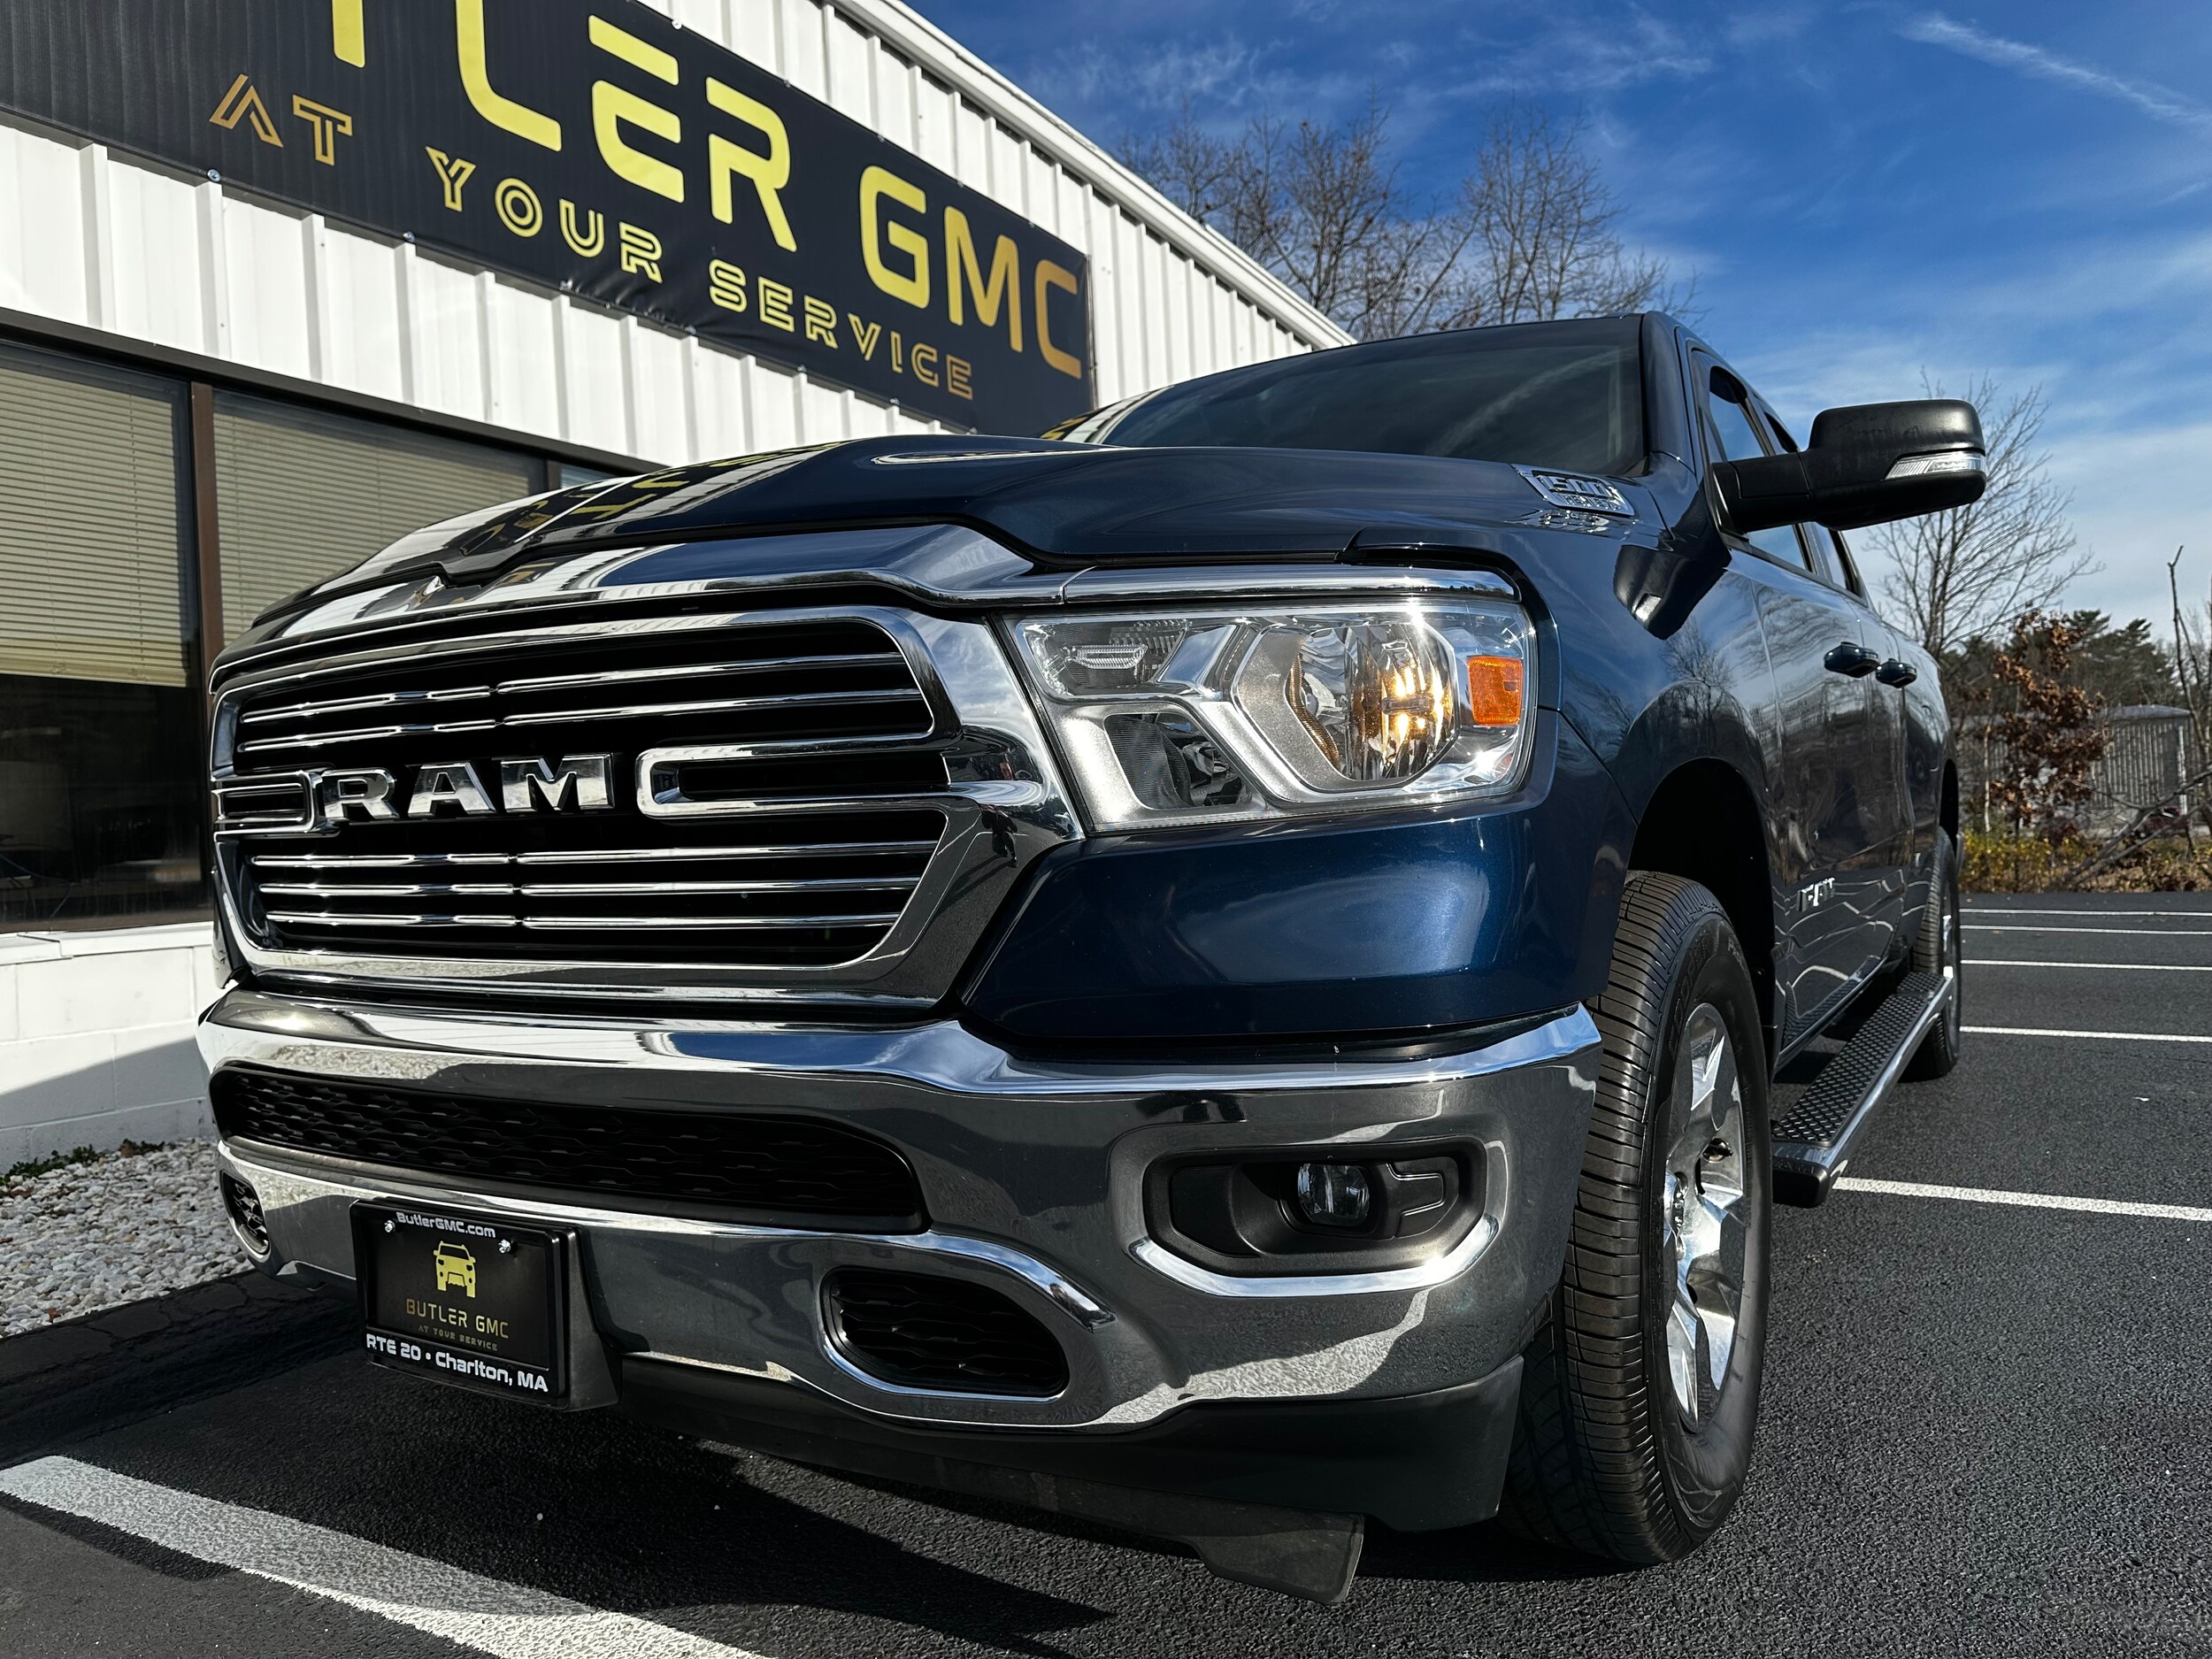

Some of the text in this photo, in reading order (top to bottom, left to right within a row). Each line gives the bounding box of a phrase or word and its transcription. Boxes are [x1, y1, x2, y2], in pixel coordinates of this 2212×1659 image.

[209, 73, 973, 400] AT YOUR SERVICE
[860, 165, 1082, 380] GMC
[319, 752, 616, 821] RAM
[396, 1211, 496, 1238] ButlerGMC.com
[406, 1298, 510, 1343] BUTLER GMC
[418, 1325, 498, 1351] AT YOUR SERVICE
[365, 1333, 549, 1393] RTE 20 Charlton, MA
